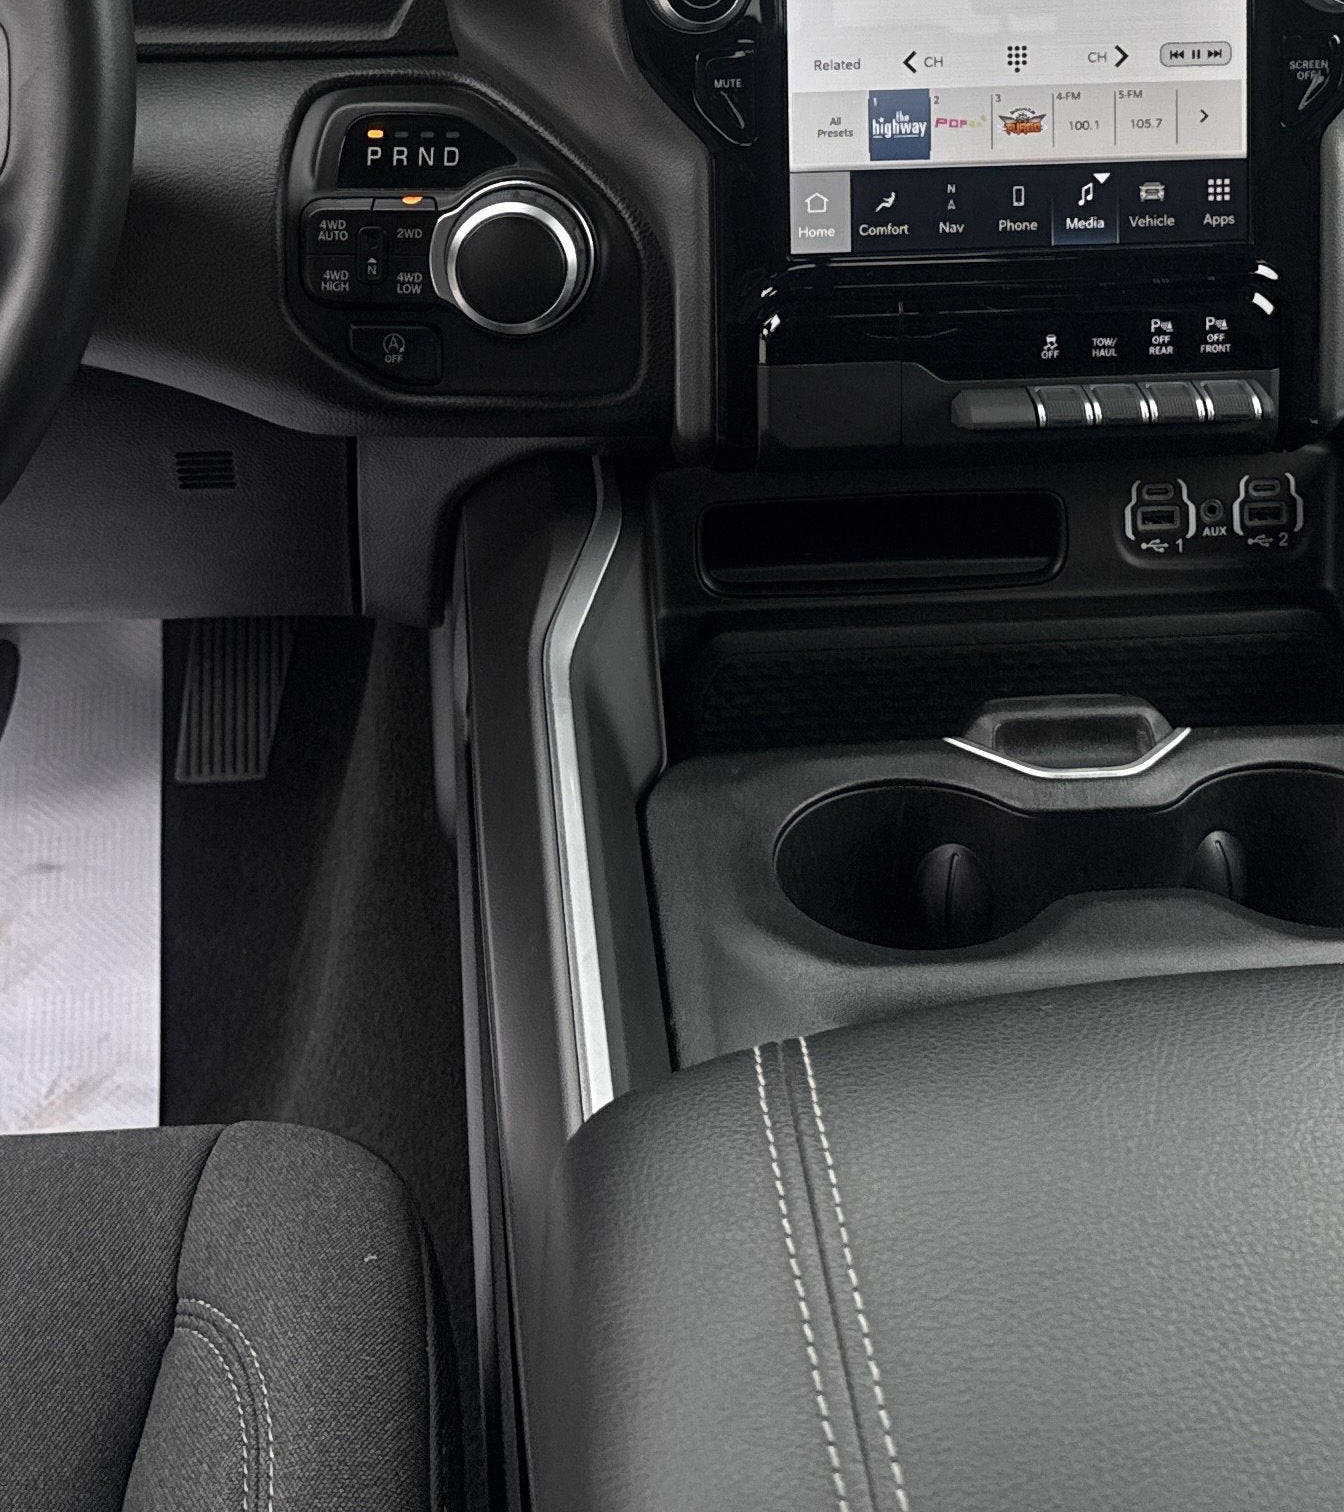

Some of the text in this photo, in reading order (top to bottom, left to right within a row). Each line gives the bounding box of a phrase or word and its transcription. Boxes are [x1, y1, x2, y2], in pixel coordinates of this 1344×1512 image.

[923, 55, 944, 68] CH
[1087, 51, 1107, 63] CH
[814, 58, 861, 71] Related
[1289, 59, 1329, 70] SCREEN
[714, 78, 743, 89] MUTE
[933, 95, 940, 105] 2
[994, 93, 1002, 103] 3
[1056, 91, 1081, 101] 4-FM
[1118, 89, 1143, 99] 5-FM
[895, 110, 910, 122] the
[872, 116, 927, 139] highway
[1069, 119, 1100, 131] 100.1
[1131, 117, 1163, 129] 105.7
[817, 128, 854, 138] Presets
[367, 146, 460, 166] P R N D
[319, 219, 347, 230] 4WD
[998, 219, 1038, 232] Phone
[1066, 215, 1105, 230] Media
[1129, 213, 1175, 228] Vehicle
[1203, 213, 1235, 228] Apps
[396, 227, 423, 239] 2WD
[798, 226, 836, 238] Home
[859, 223, 909, 237] Comfort
[939, 221, 965, 234] Nav
[318, 230, 349, 242] AUTO
[323, 269, 349, 280] 4WD
[367, 265, 378, 275] N
[396, 272, 423, 283] 4WD
[321, 281, 349, 292] HIGH
[396, 283, 423, 295] LOW
[1091, 336, 1118, 347] TOW/
[1151, 334, 1171, 345] OFF
[1206, 332, 1226, 343] OFF
[1041, 349, 1060, 360] OFF
[1091, 348, 1118, 358] HAUL
[1148, 345, 1174, 355] REAR
[1199, 343, 1232, 354] FRONT
[384, 354, 404, 364] OFF
[1202, 525, 1227, 537] AUX
[1175, 538, 1184, 553] 1
[1278, 532, 1289, 547] 2
